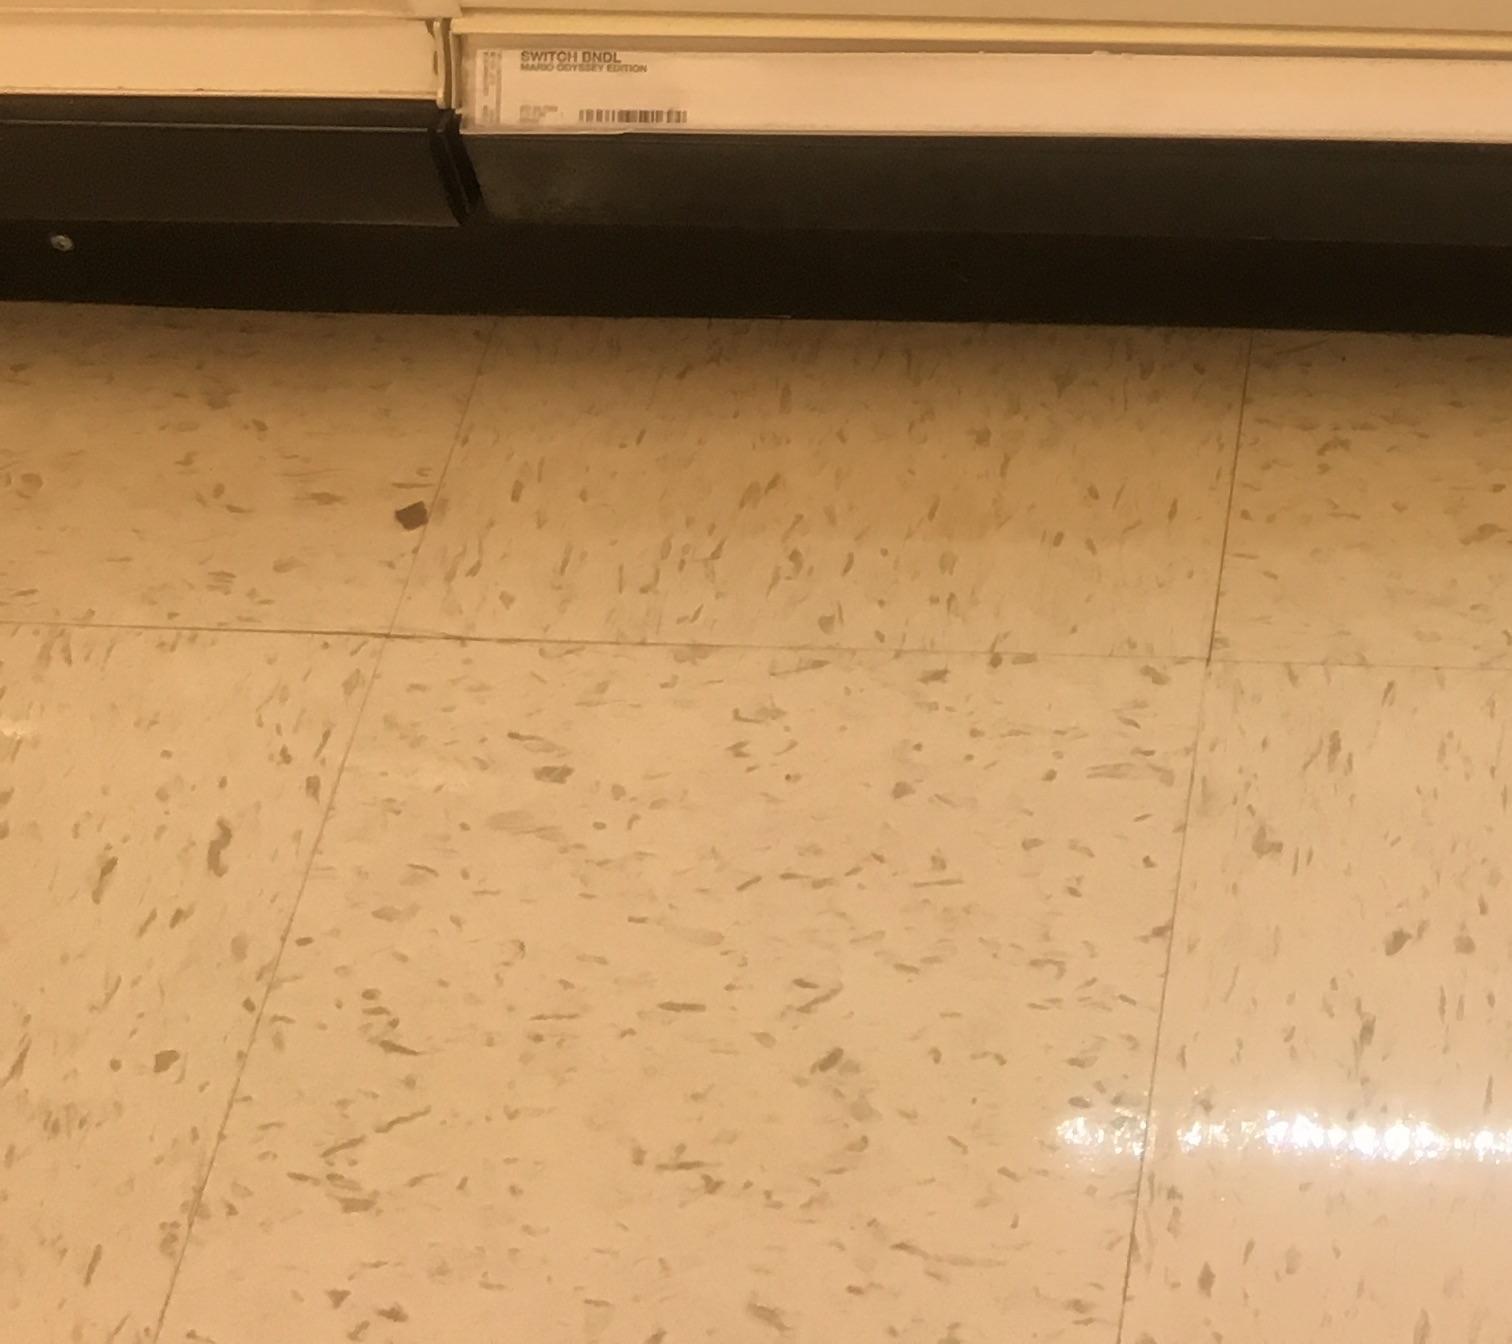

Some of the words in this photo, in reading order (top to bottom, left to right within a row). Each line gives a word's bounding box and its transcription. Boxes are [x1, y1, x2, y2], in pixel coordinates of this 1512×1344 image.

[521, 50, 578, 63] SWITCH
[581, 51, 622, 64] BNDL
[520, 63, 553, 72] MARIO
[556, 63, 604, 72] ODYSSEY
[606, 63, 648, 73] EDITION
